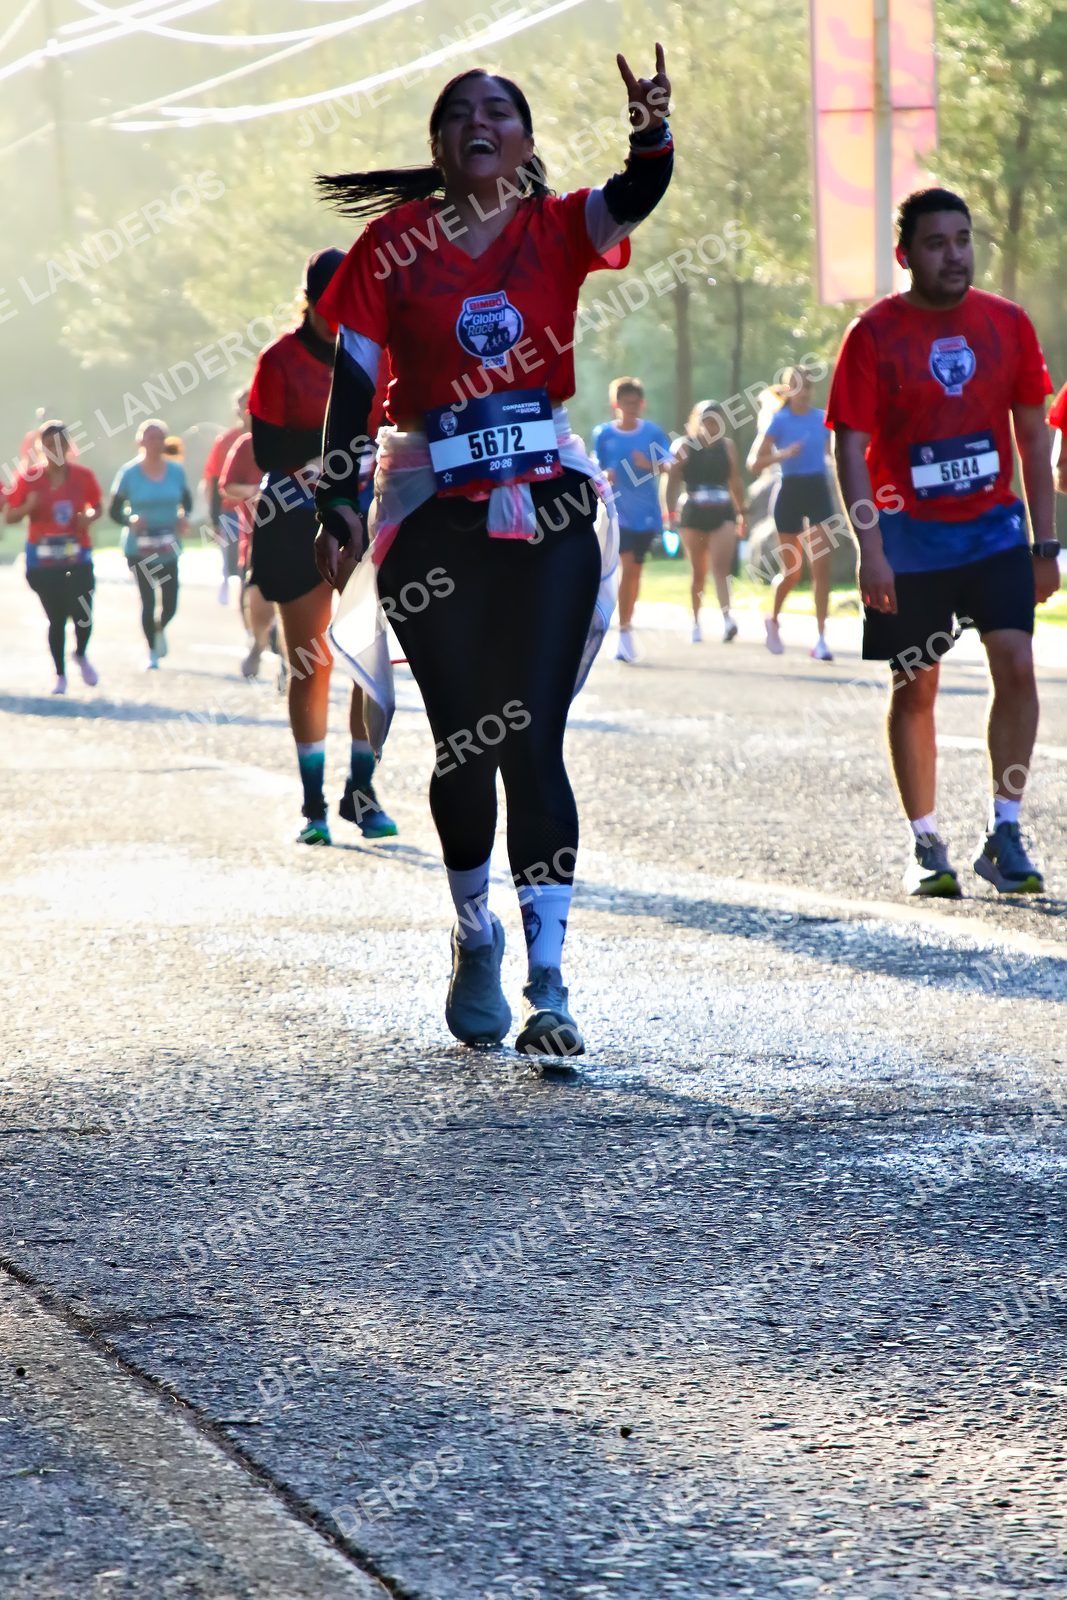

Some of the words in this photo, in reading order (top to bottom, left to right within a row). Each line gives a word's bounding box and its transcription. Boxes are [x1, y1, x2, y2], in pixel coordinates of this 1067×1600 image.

[472, 311, 505, 326] Global
[468, 323, 495, 337] Race
[468, 425, 525, 460] 5672
[534, 466, 552, 475] 10K
[940, 457, 980, 482] 5644
